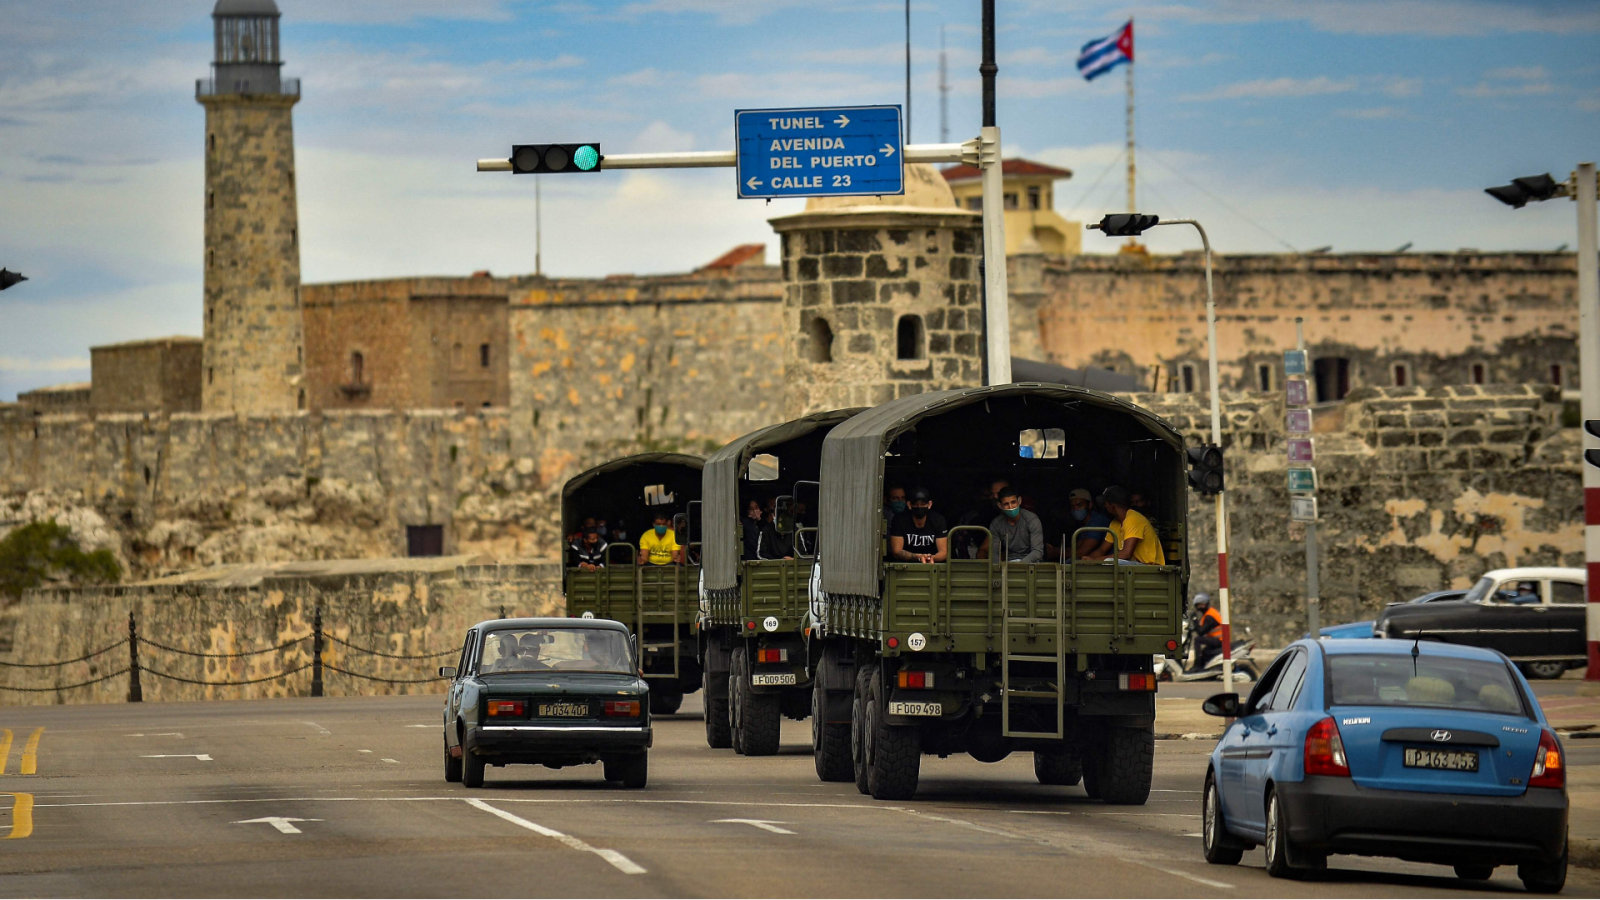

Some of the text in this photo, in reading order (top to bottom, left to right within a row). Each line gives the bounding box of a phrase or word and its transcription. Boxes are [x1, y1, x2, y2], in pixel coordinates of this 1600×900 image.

[769, 117, 824, 130] TUNEL
[770, 138, 845, 151] AVENIDA
[770, 155, 876, 169] DEL PUERTO
[771, 175, 851, 189] CALLE 23
[906, 533, 935, 547] VLTN
[1343, 717, 1371, 725] HYUNDAI
